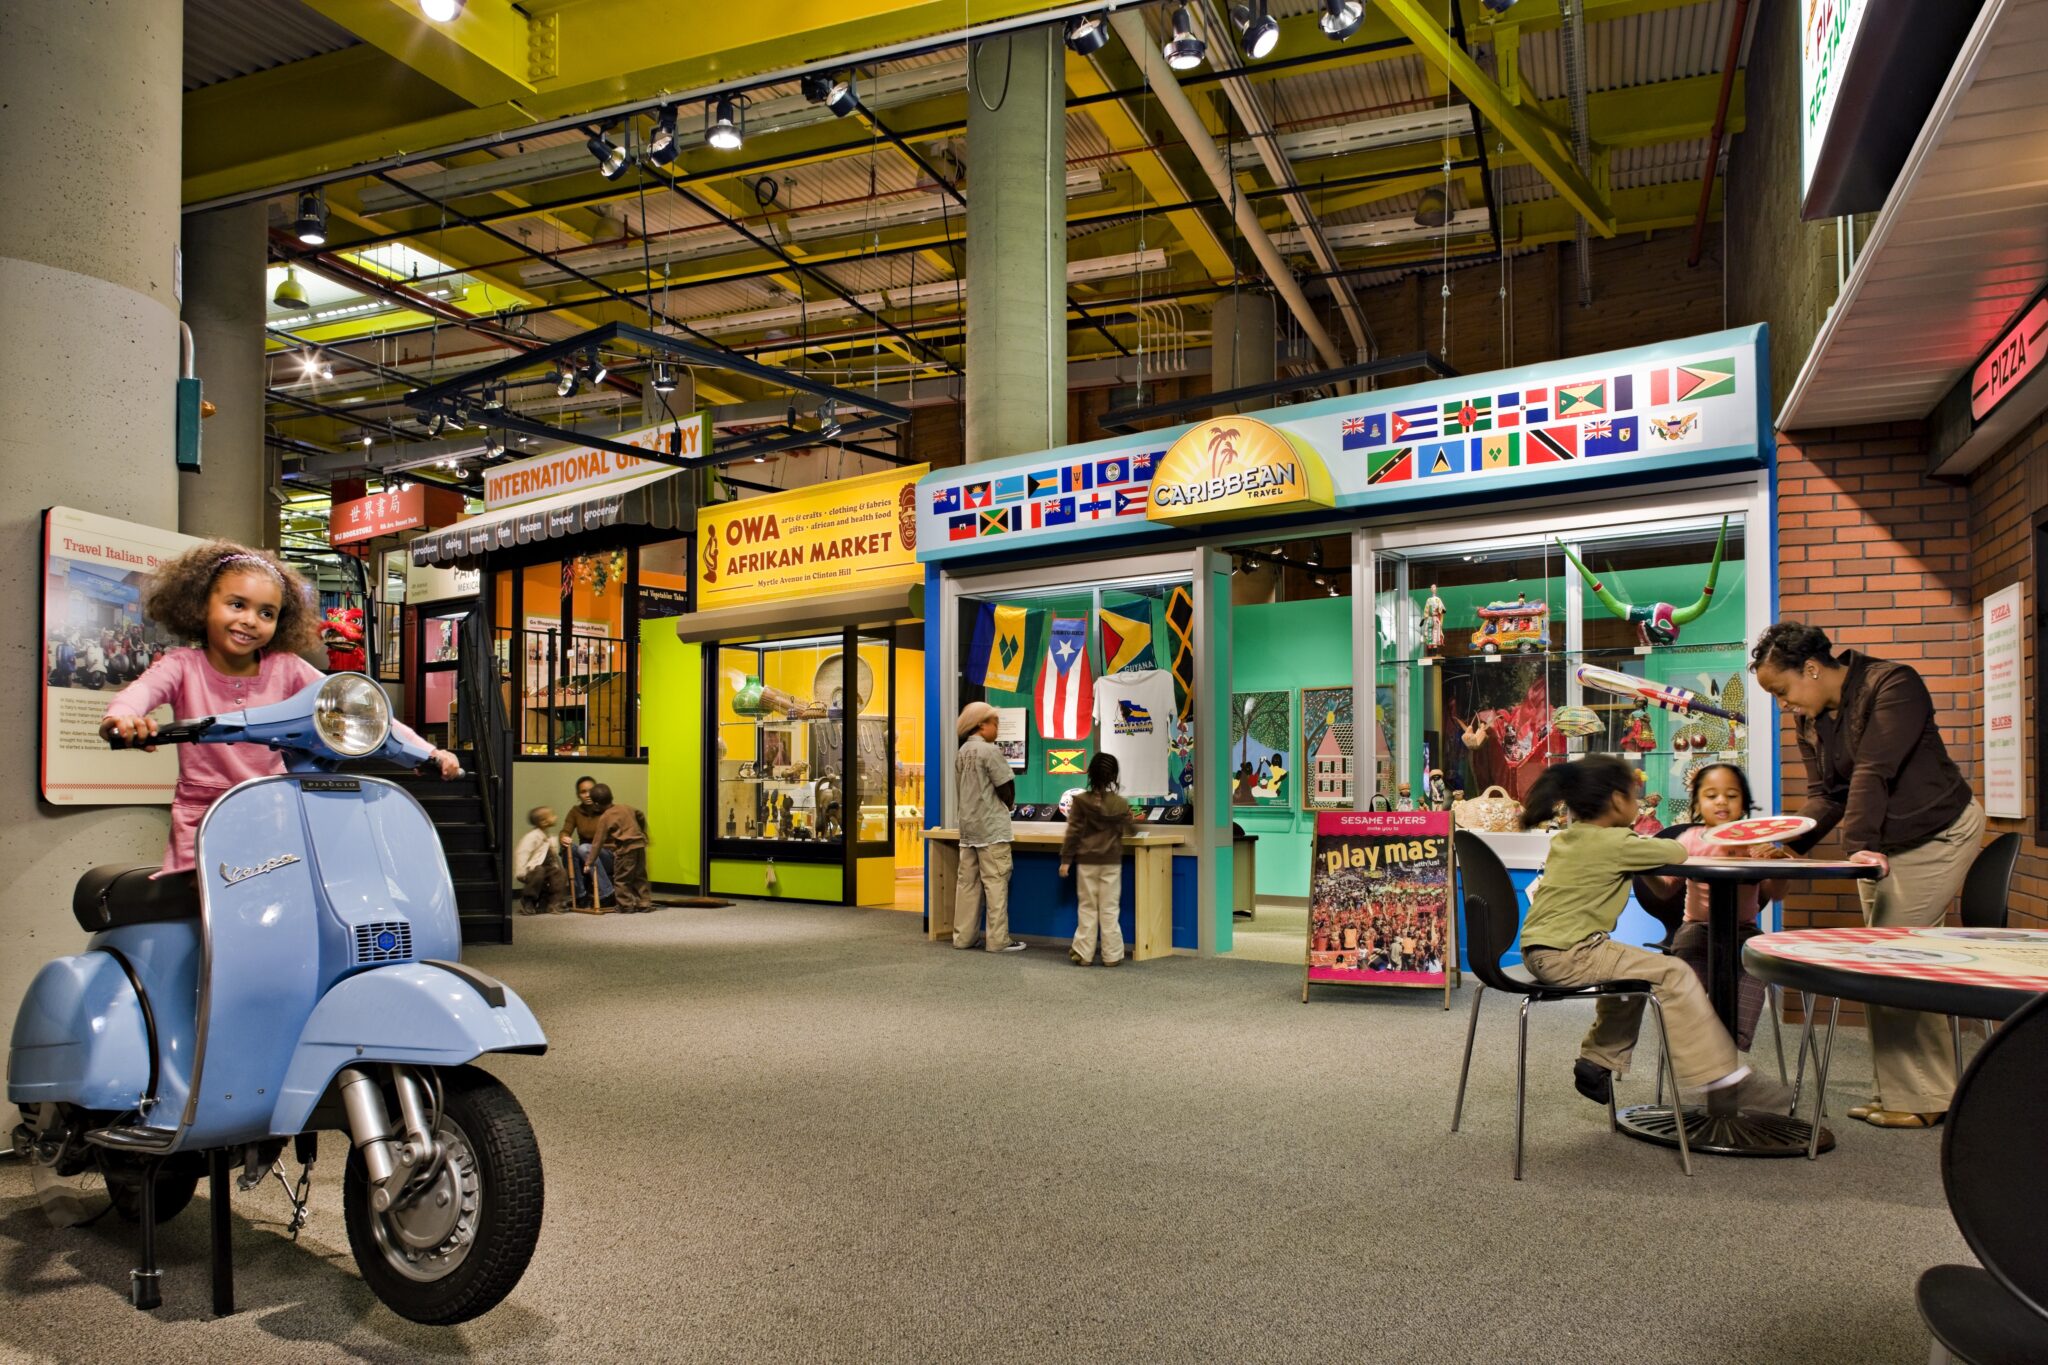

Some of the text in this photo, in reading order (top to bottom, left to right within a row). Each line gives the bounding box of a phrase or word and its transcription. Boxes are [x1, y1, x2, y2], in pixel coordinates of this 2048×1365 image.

[1810, 0, 1851, 137] RESTAU
[1991, 332, 2026, 396] PIZZA
[488, 451, 610, 502] INTERNATIONAL
[1154, 463, 1296, 506] CARIBBEAN
[1248, 487, 1283, 499] TRAVEL
[349, 494, 400, 523] 世界書局
[781, 515, 794, 524] arts
[802, 510, 822, 521] crafts
[829, 503, 858, 517] clothing
[859, 502, 866, 511] &
[866, 499, 892, 510] fabrics
[413, 503, 619, 556] produce dairy meats fish frozen bread groceries
[726, 514, 780, 546] OWA
[789, 510, 892, 535] gifts african and health food
[63, 538, 101, 557] Travel
[105, 546, 143, 565] Italian
[727, 531, 893, 576] AFRIKAN MARKET
[453, 567, 480, 581] PAN
[457, 580, 480, 593] MEXICA
[757, 568, 852, 587] Myrtle Avenue in Clinton Hill
[1991, 603, 2011, 621] PIZZA
[1124, 660, 1154, 672] GUYANA
[1991, 715, 2012, 728] SLICES
[1340, 816, 1426, 825] SESAME FLYERS
